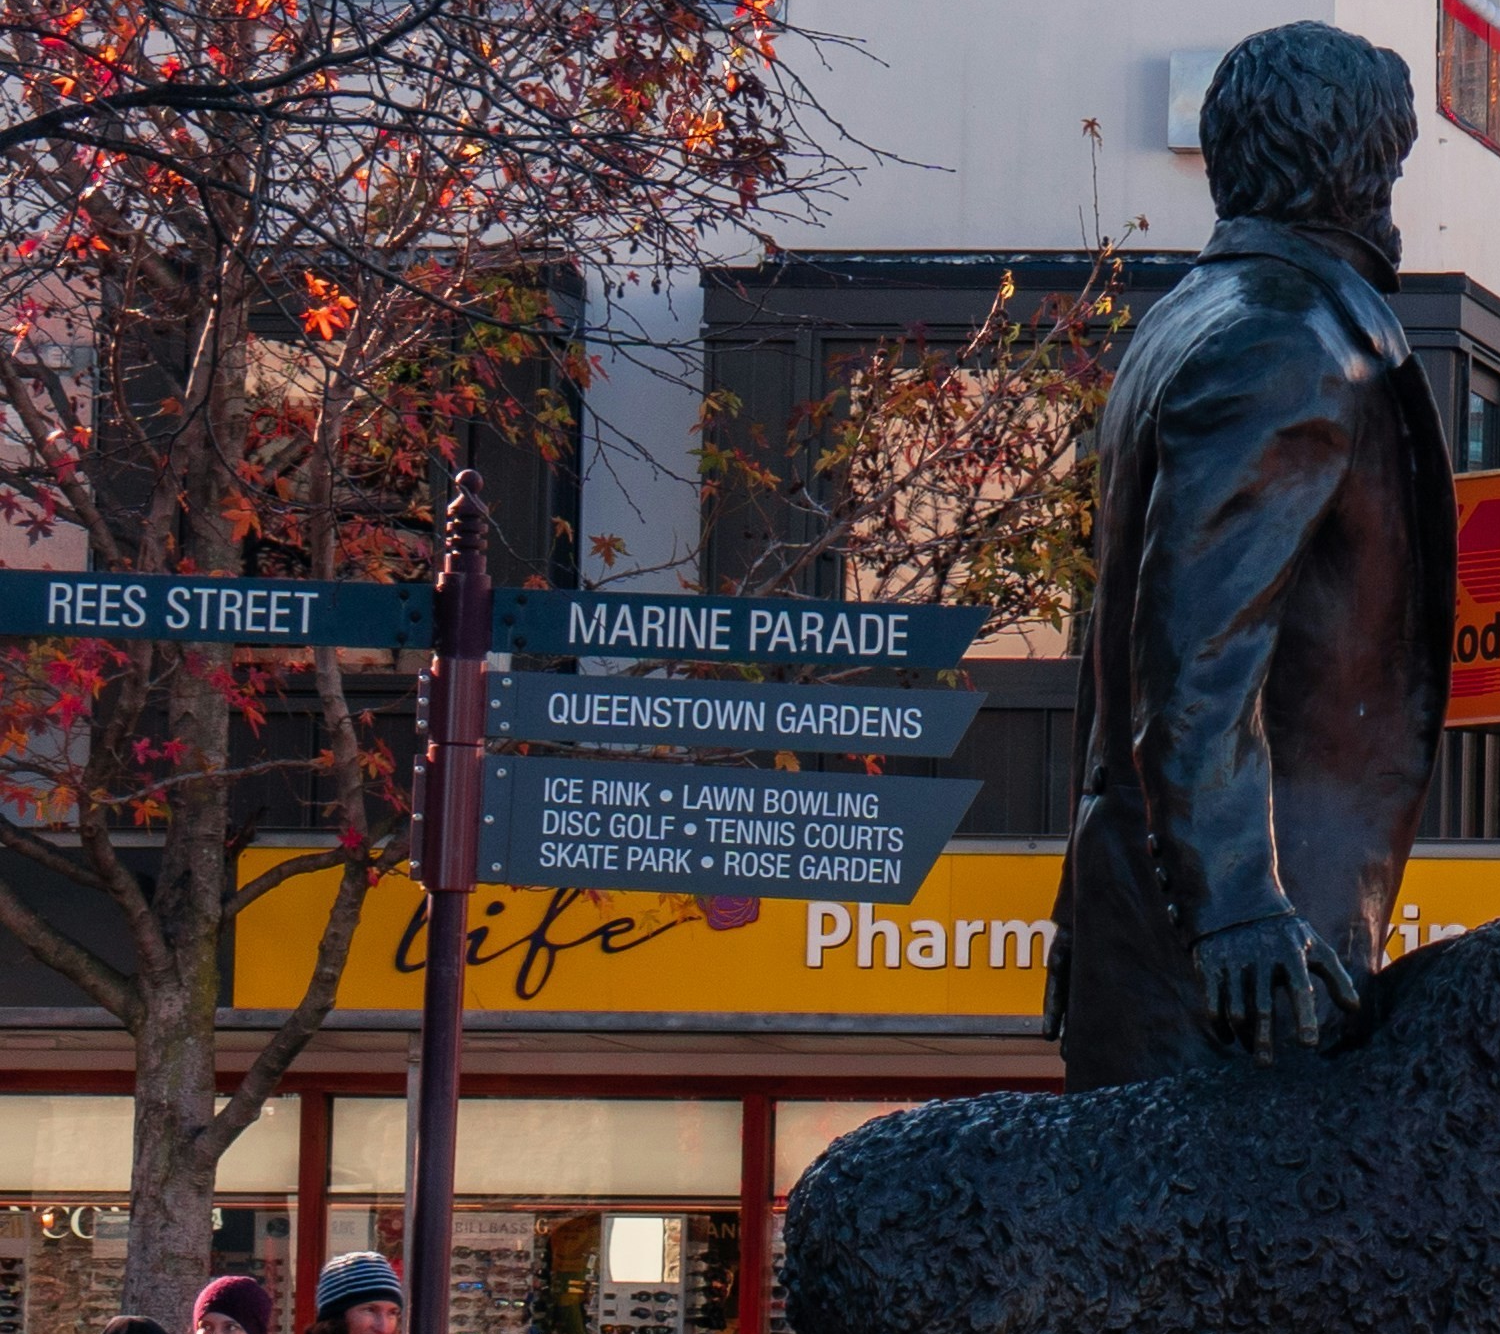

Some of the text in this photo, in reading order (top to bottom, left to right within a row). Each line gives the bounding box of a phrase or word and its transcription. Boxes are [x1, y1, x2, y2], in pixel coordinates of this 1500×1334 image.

[47, 582, 319, 634] REES STREET
[568, 602, 909, 657] MARINE PARADE
[548, 692, 923, 739] QUEENSTOWN GARDENS
[543, 777, 879, 819] ICE RINK LAWN BOWLING
[542, 810, 904, 853] DISC GOLF TENNIS COURTS
[539, 842, 901, 884] SKATE PARK ROSE GARDEN
[807, 902, 1056, 968] Pharm
